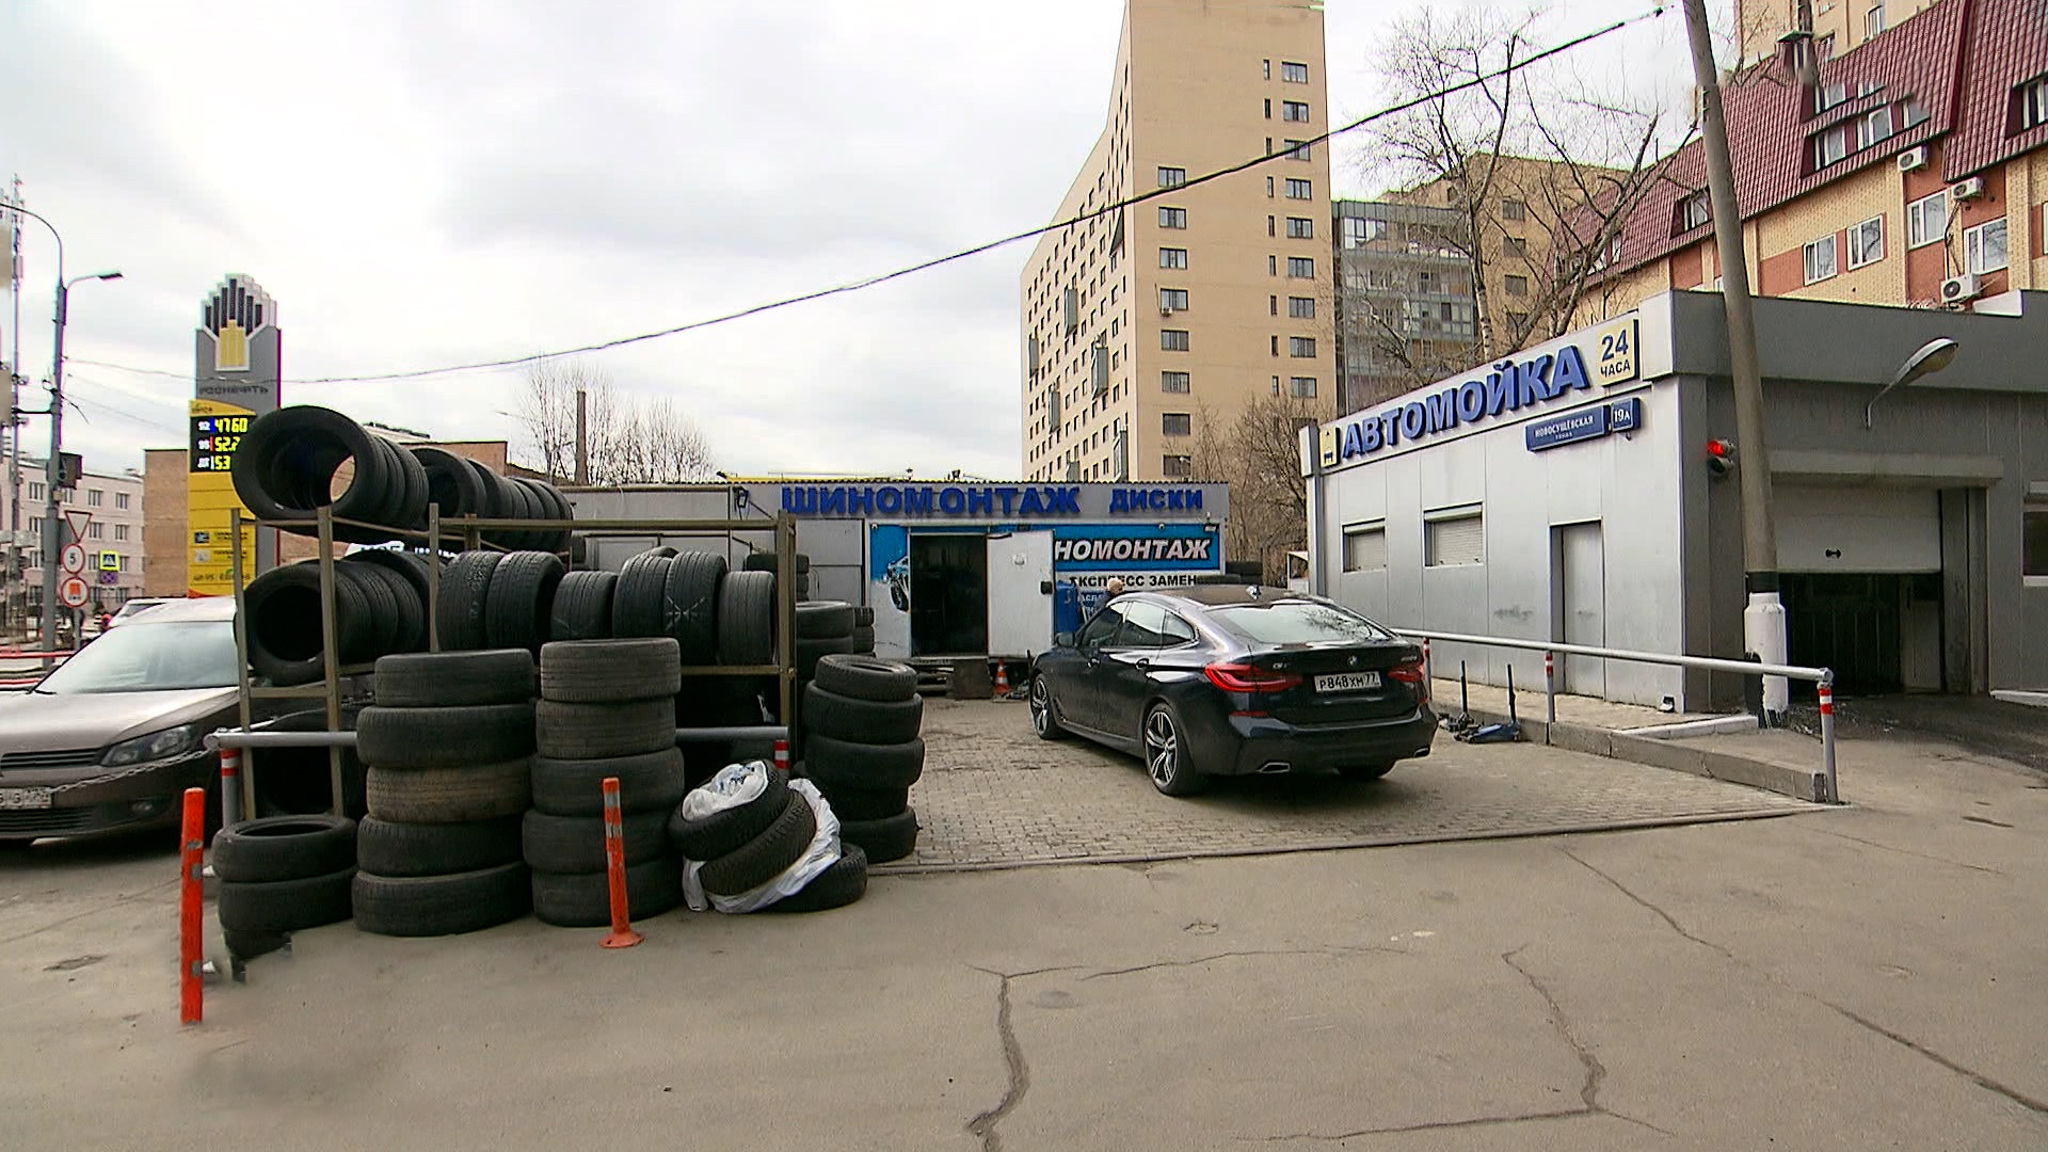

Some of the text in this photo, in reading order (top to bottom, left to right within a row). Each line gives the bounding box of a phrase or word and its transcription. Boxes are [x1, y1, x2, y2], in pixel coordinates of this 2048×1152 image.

[1601, 328, 1629, 362] 24
[1600, 359, 1631, 378] ЧАСА
[1342, 345, 1590, 459] АВТОМОЙКА
[1614, 408, 1631, 423] 19А
[782, 486, 1203, 514] ШИНОМОНТАЖ ДИСКИ
[70, 552, 76, 565] 5
